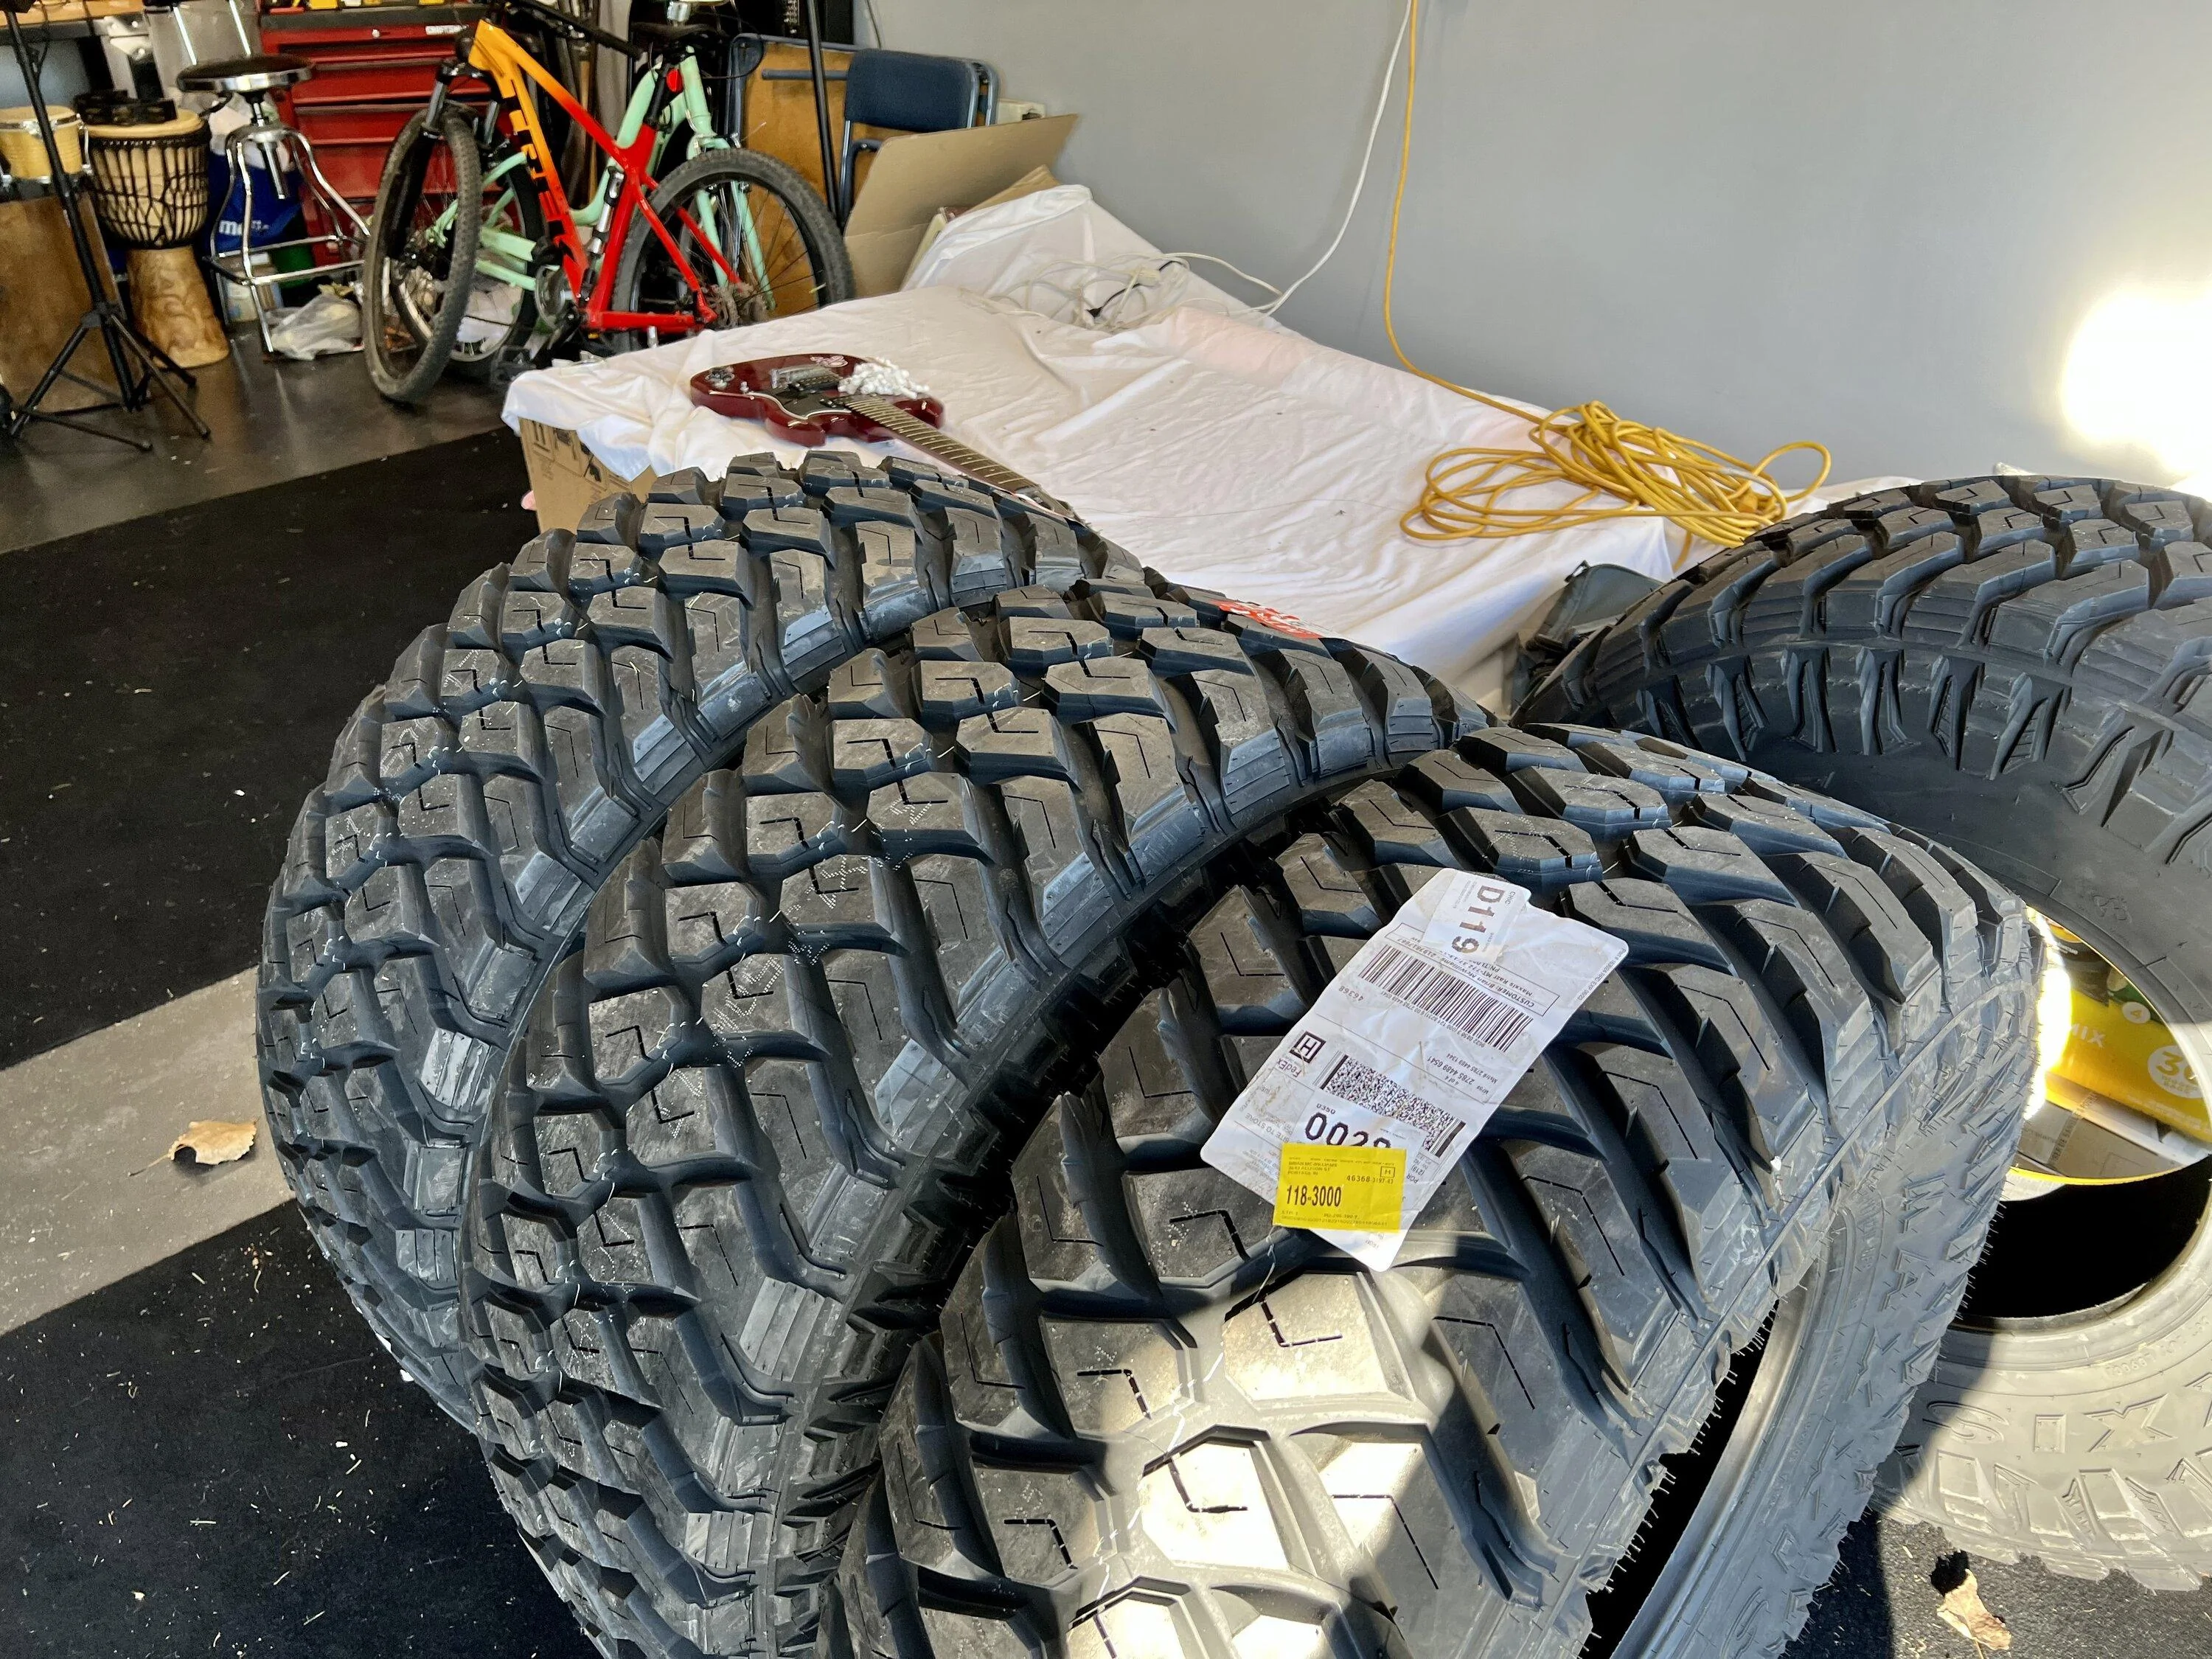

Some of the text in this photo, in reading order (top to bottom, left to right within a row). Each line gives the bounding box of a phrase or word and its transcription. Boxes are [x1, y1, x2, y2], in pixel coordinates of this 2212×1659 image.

[1503, 890, 1516, 905] CHIC
[1451, 885, 1504, 955] D119
[1476, 975, 1495, 988] Brian
[1338, 984, 1364, 1002] 46368
[1494, 984, 1534, 1008] CUSTOMER:
[1274, 1057, 1302, 1078] FedEx
[1426, 1054, 1444, 1068] 6541
[1441, 1063, 1459, 1077] 4489
[1457, 1071, 1475, 1085] 2785
[1244, 1111, 1267, 1129] STORE
[1265, 1125, 1276, 1134] TO
[1304, 1112, 1392, 1149] 002
[1287, 1184, 1342, 1207] 118-3000
